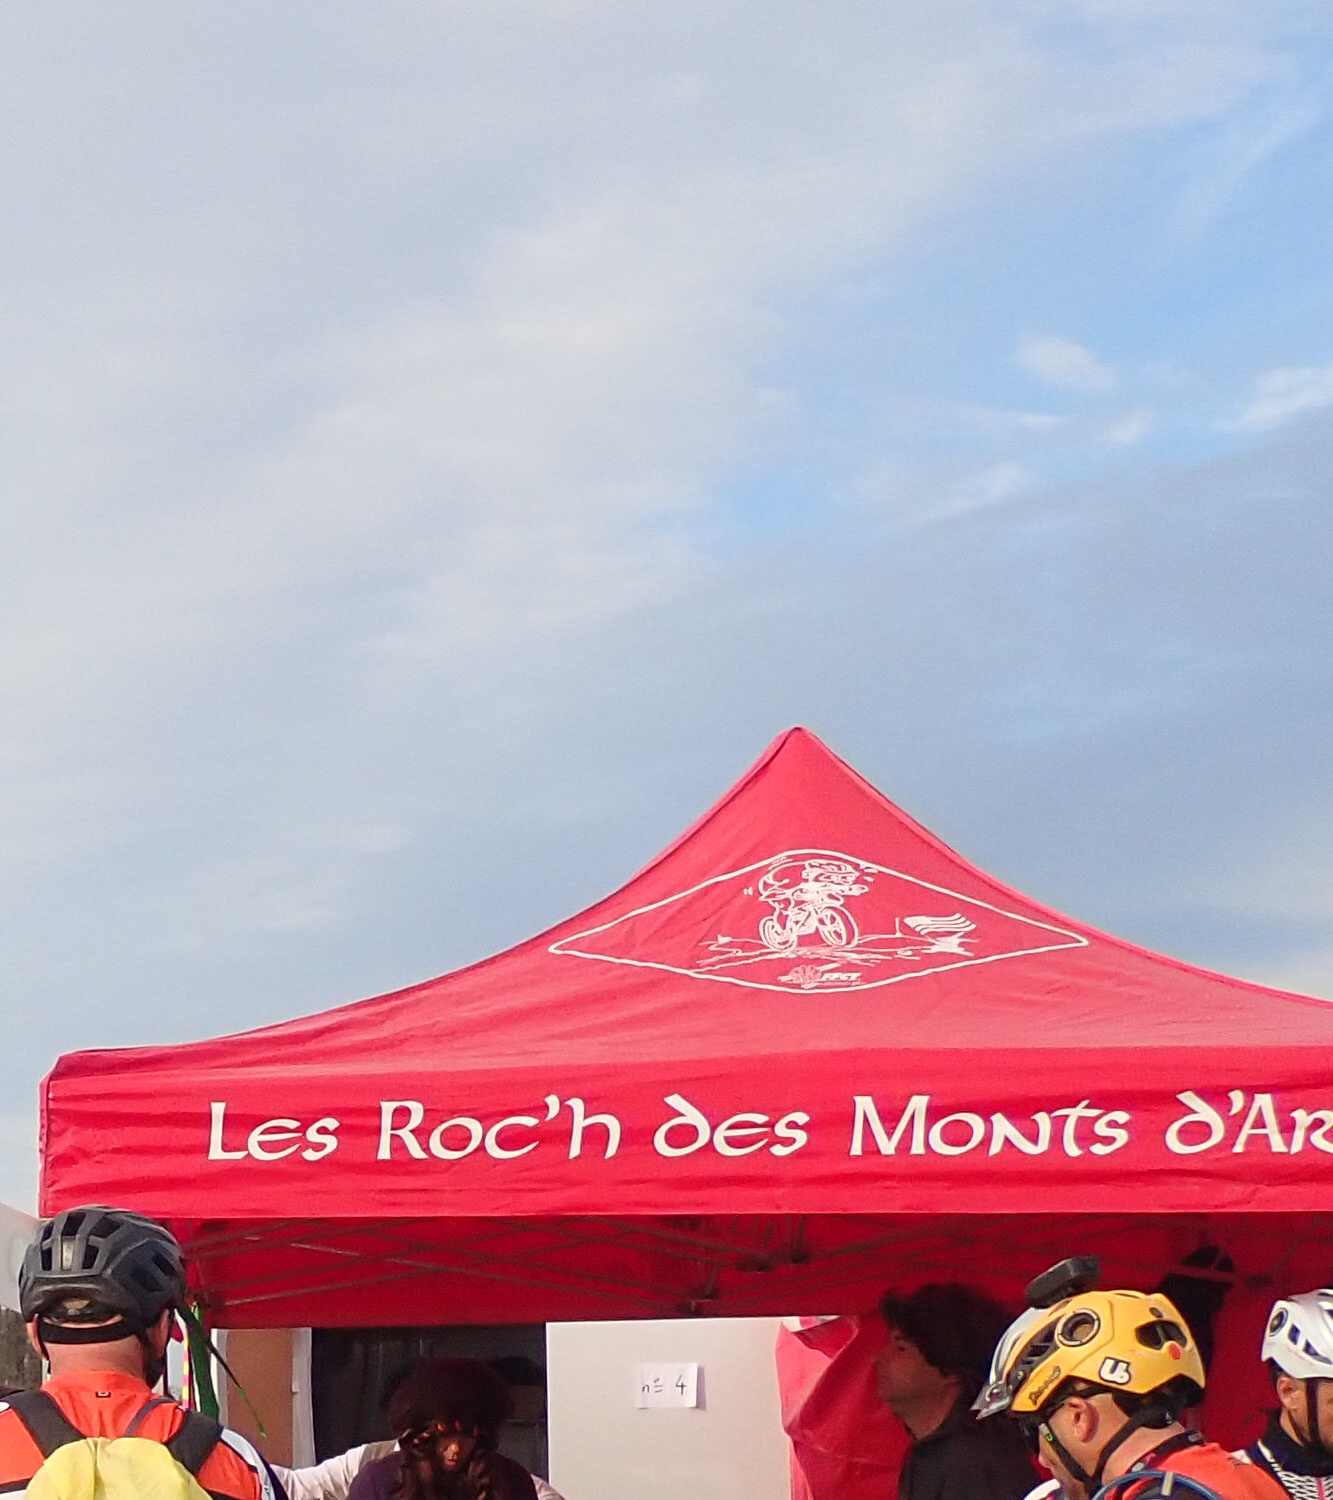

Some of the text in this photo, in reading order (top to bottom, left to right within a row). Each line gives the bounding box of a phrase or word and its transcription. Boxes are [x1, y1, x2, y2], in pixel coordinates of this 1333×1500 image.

[206, 1101, 340, 1162] Les
[377, 1094, 623, 1161] Roc'h
[653, 1093, 810, 1158] des
[848, 1094, 1132, 1158] Monts
[675, 1374, 687, 1396] 4
